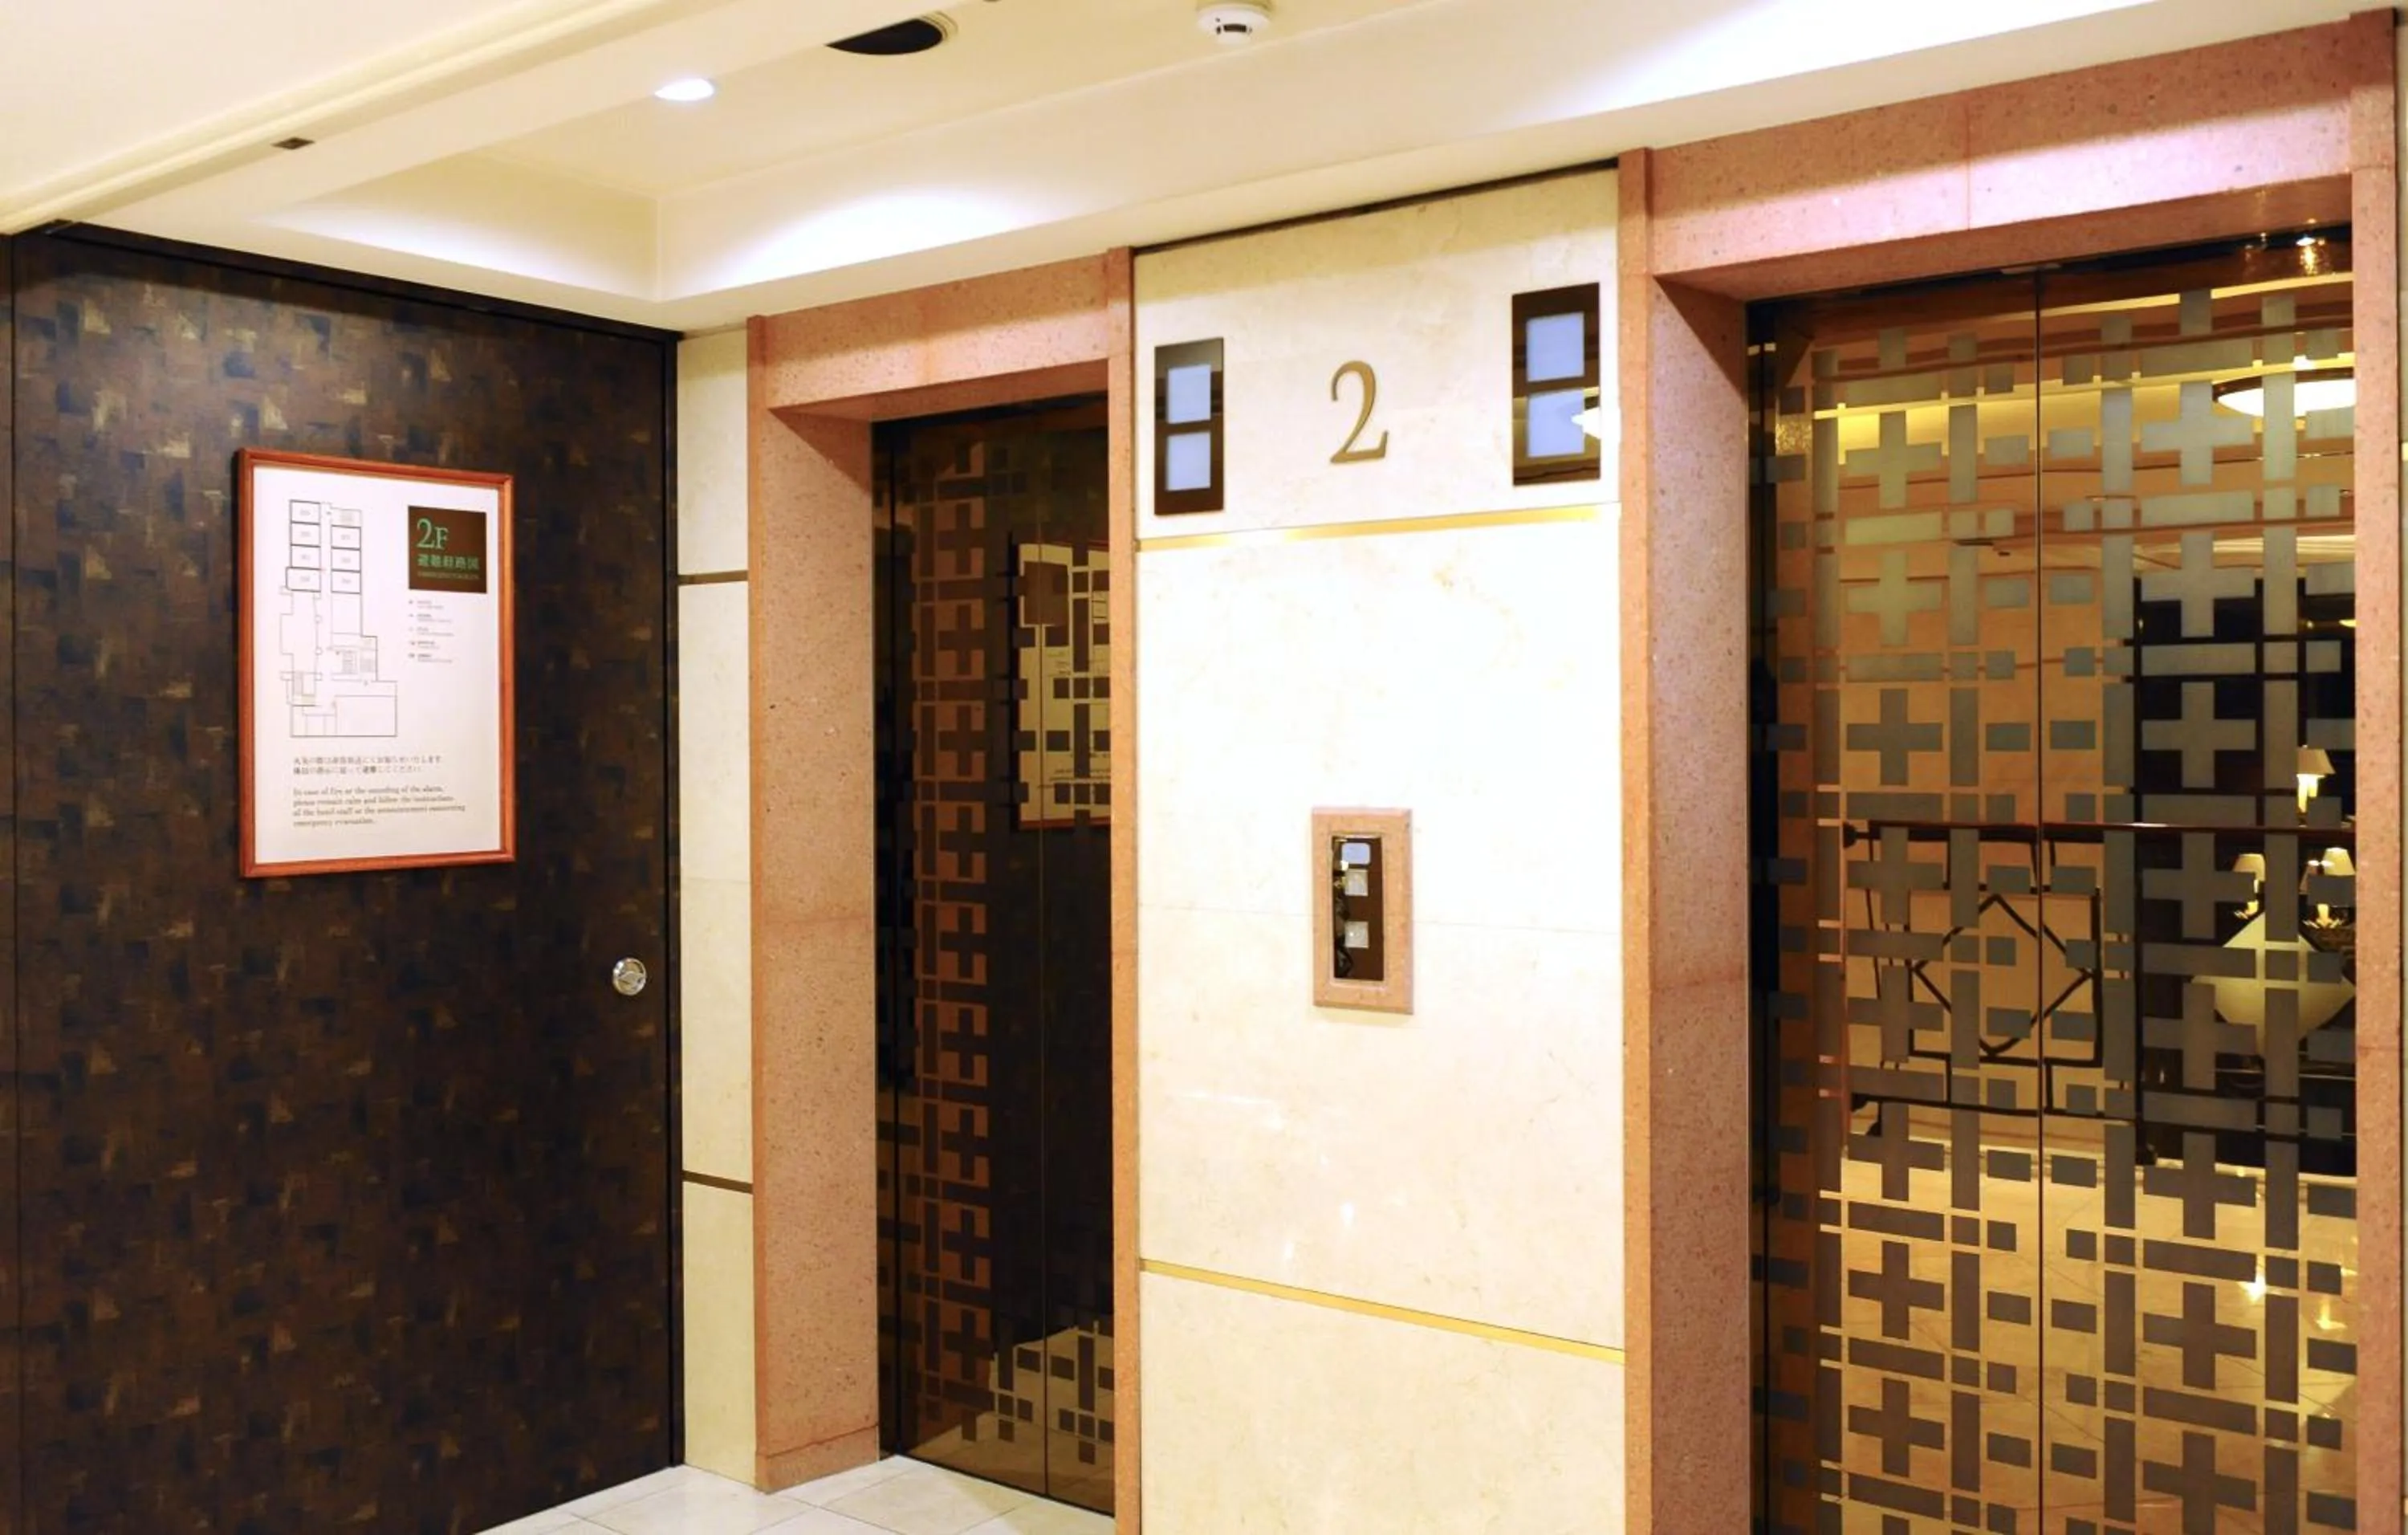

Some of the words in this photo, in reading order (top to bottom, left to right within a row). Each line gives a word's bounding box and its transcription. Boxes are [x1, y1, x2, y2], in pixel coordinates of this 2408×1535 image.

[1330, 360, 1389, 463] 2
[417, 518, 449, 550] 2F
[330, 788, 343, 796] fire
[364, 796, 376, 804] and
